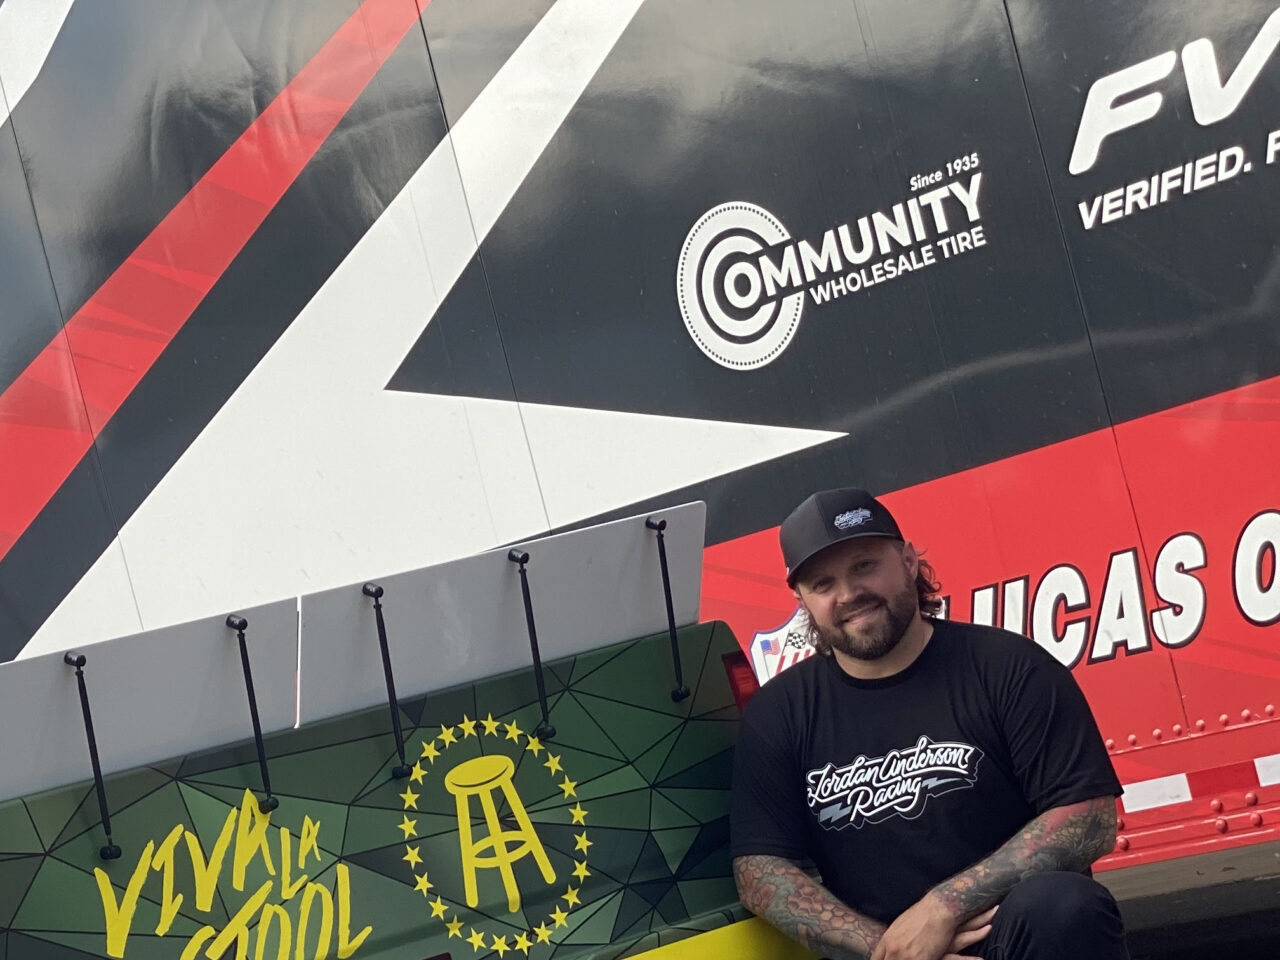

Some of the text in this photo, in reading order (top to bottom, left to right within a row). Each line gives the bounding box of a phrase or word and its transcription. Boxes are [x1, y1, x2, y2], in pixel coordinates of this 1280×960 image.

[910, 153, 980, 192] Since 1935
[1078, 146, 1252, 231] VERIFIED.
[695, 172, 983, 345] COMMUNITY
[809, 226, 987, 305] WHOLESALE TIRE
[925, 531, 1208, 671] CAS
[807, 736, 975, 807] Jordan Anderson
[847, 777, 922, 822] Racing
[94, 788, 322, 958] VIVA LA
